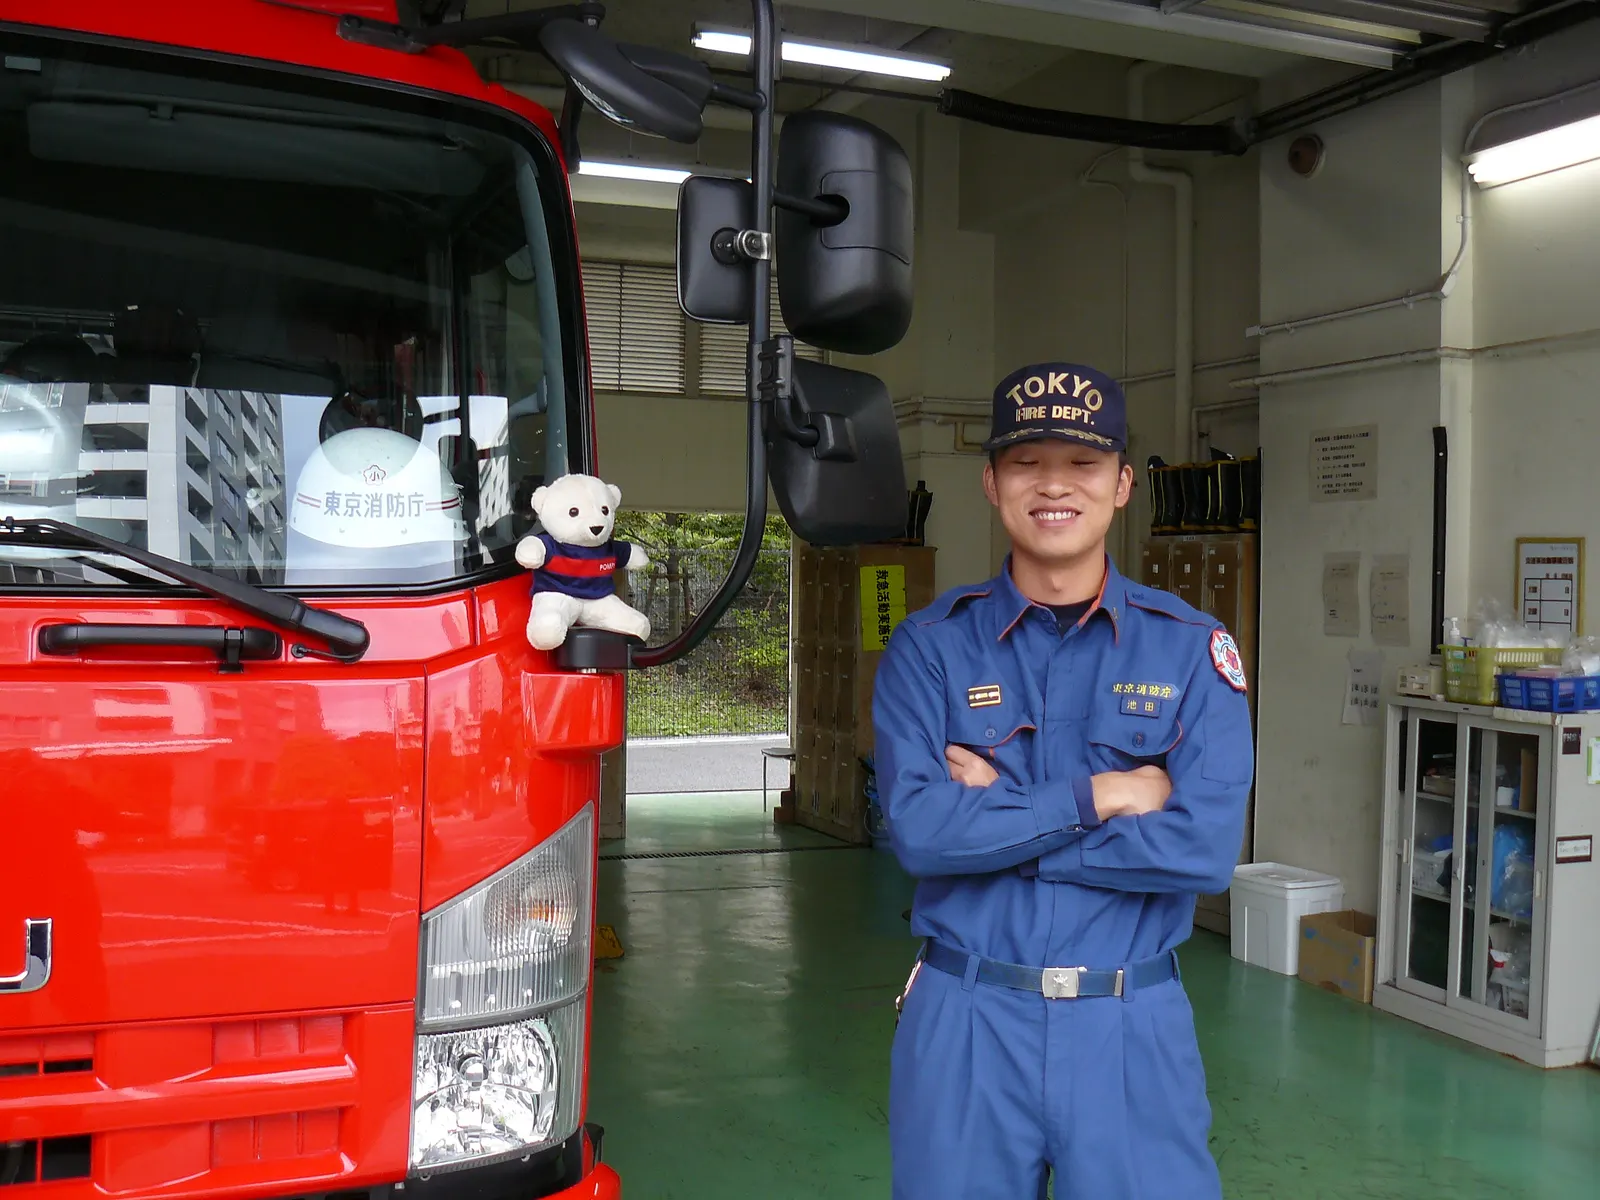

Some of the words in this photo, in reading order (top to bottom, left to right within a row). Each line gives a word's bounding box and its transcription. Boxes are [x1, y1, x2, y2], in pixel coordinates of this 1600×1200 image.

[1005, 372, 1103, 411] TOKYO
[1015, 405, 1047, 422] FIRE
[1052, 405, 1095, 425] DEPT.
[323, 490, 424, 519] 東京消防庁
[1112, 683, 1172, 698] 東京消防庁
[1126, 699, 1155, 712] 池田
